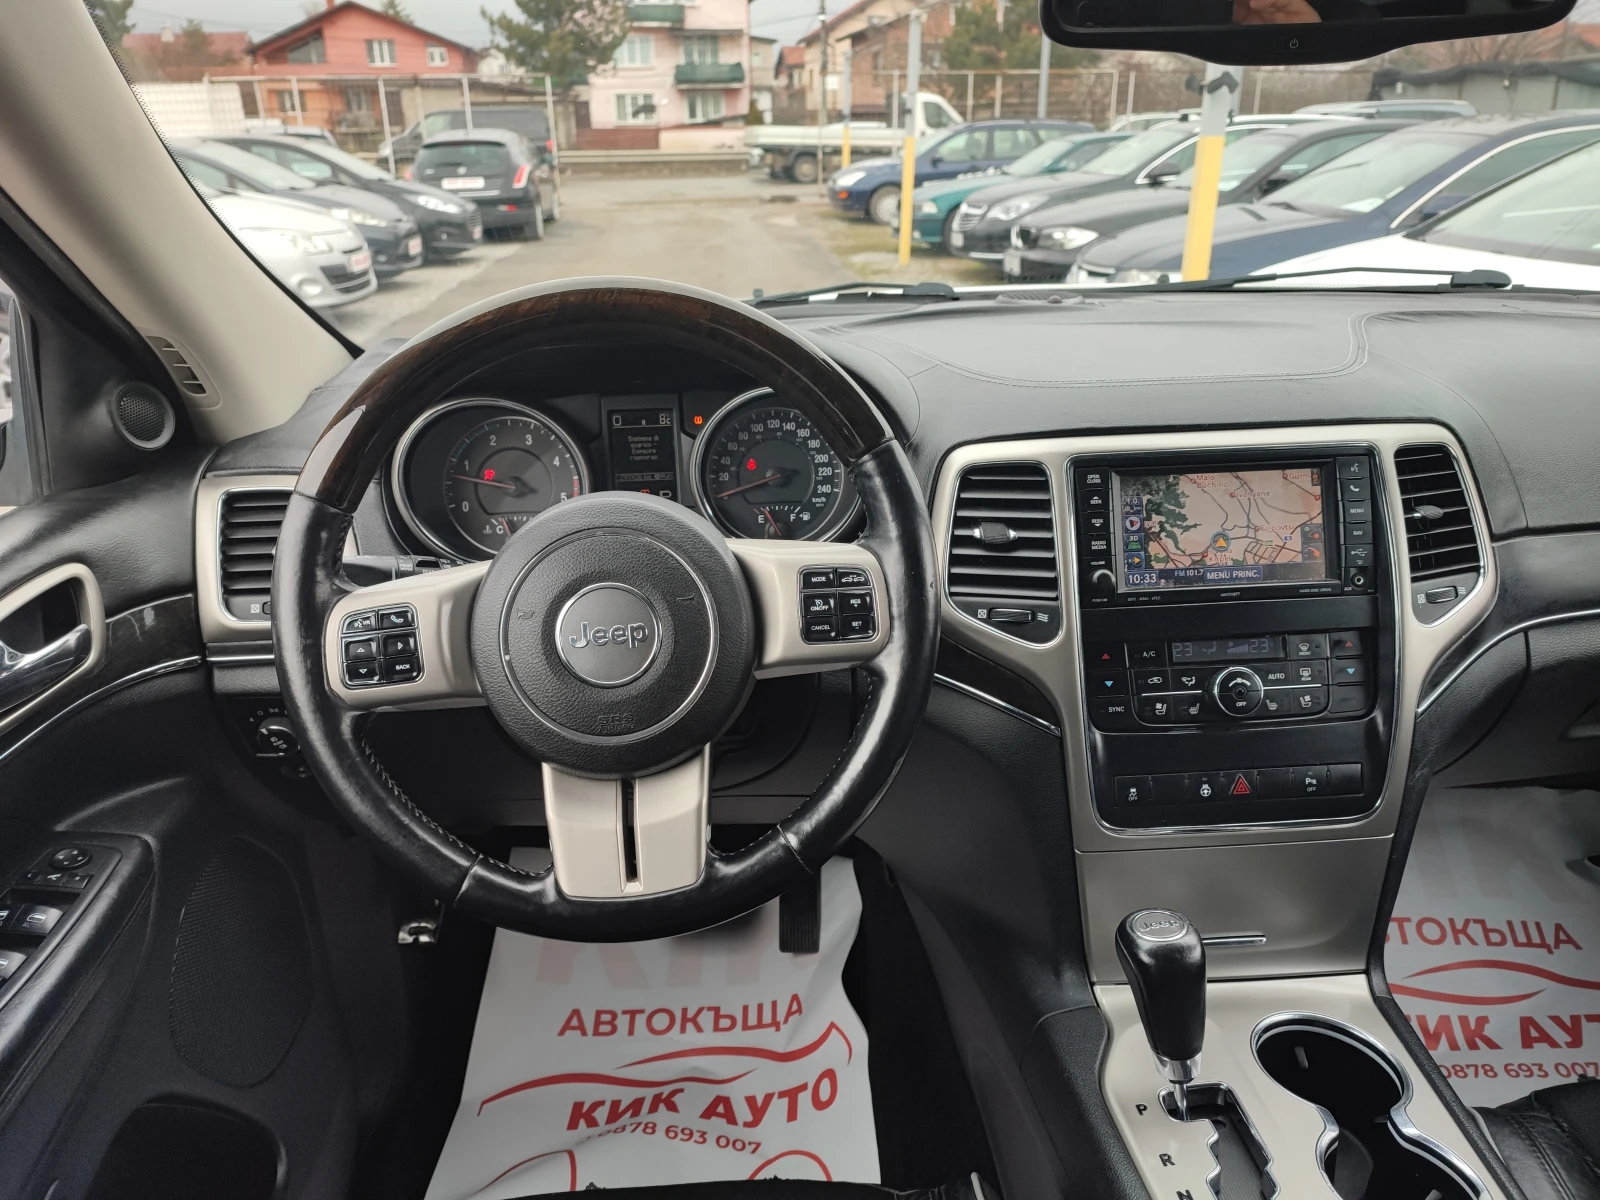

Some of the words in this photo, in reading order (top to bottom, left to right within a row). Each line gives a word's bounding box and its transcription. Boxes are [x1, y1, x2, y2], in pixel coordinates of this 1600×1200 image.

[750, 423, 764, 432] 100
[767, 419, 780, 428] 120
[782, 422, 796, 431] 140
[738, 431, 749, 440] 80
[796, 428, 810, 437] 160
[489, 435, 497, 446] 2
[525, 434, 532, 445] 3
[727, 442, 738, 451] 60
[807, 440, 820, 449] 180
[553, 456, 560, 467] 4
[720, 456, 731, 465] 40
[814, 454, 829, 463] 200
[464, 460, 469, 470] 1
[818, 467, 832, 476] 220
[718, 472, 729, 481] 20
[817, 485, 831, 493] 240
[560, 492, 567, 501] 5
[462, 501, 469, 512] 0
[758, 515, 765, 523] E
[790, 514, 796, 522] F
[496, 526, 504, 534] C
[1186, 569, 1204, 577] 101.7
[1206, 570, 1231, 580] MENU
[1232, 569, 1261, 579] PRINC.
[1128, 574, 1157, 584] 10:33
[568, 621, 649, 649] Jeep
[1174, 642, 1193, 657] 23
[1249, 638, 1269, 653] 23
[1142, 650, 1157, 659] A/C
[1267, 672, 1286, 681] AUTO
[1108, 705, 1126, 714] SYNC
[1139, 919, 1181, 931] Jeep
[1384, 916, 1584, 955] ТОКЪЩА
[557, 993, 804, 1037] АВТОКЪЩА
[1404, 1014, 1504, 1051] ИК
[1503, 1063, 1549, 1079] 693
[565, 1088, 686, 1131] КИК
[698, 1068, 838, 1129] АУТО
[1135, 1104, 1149, 1116] P
[664, 1124, 708, 1145] 693
[715, 1134, 762, 1155] 007
[1158, 1153, 1176, 1167] R
[1176, 1190, 1194, 1200] N
